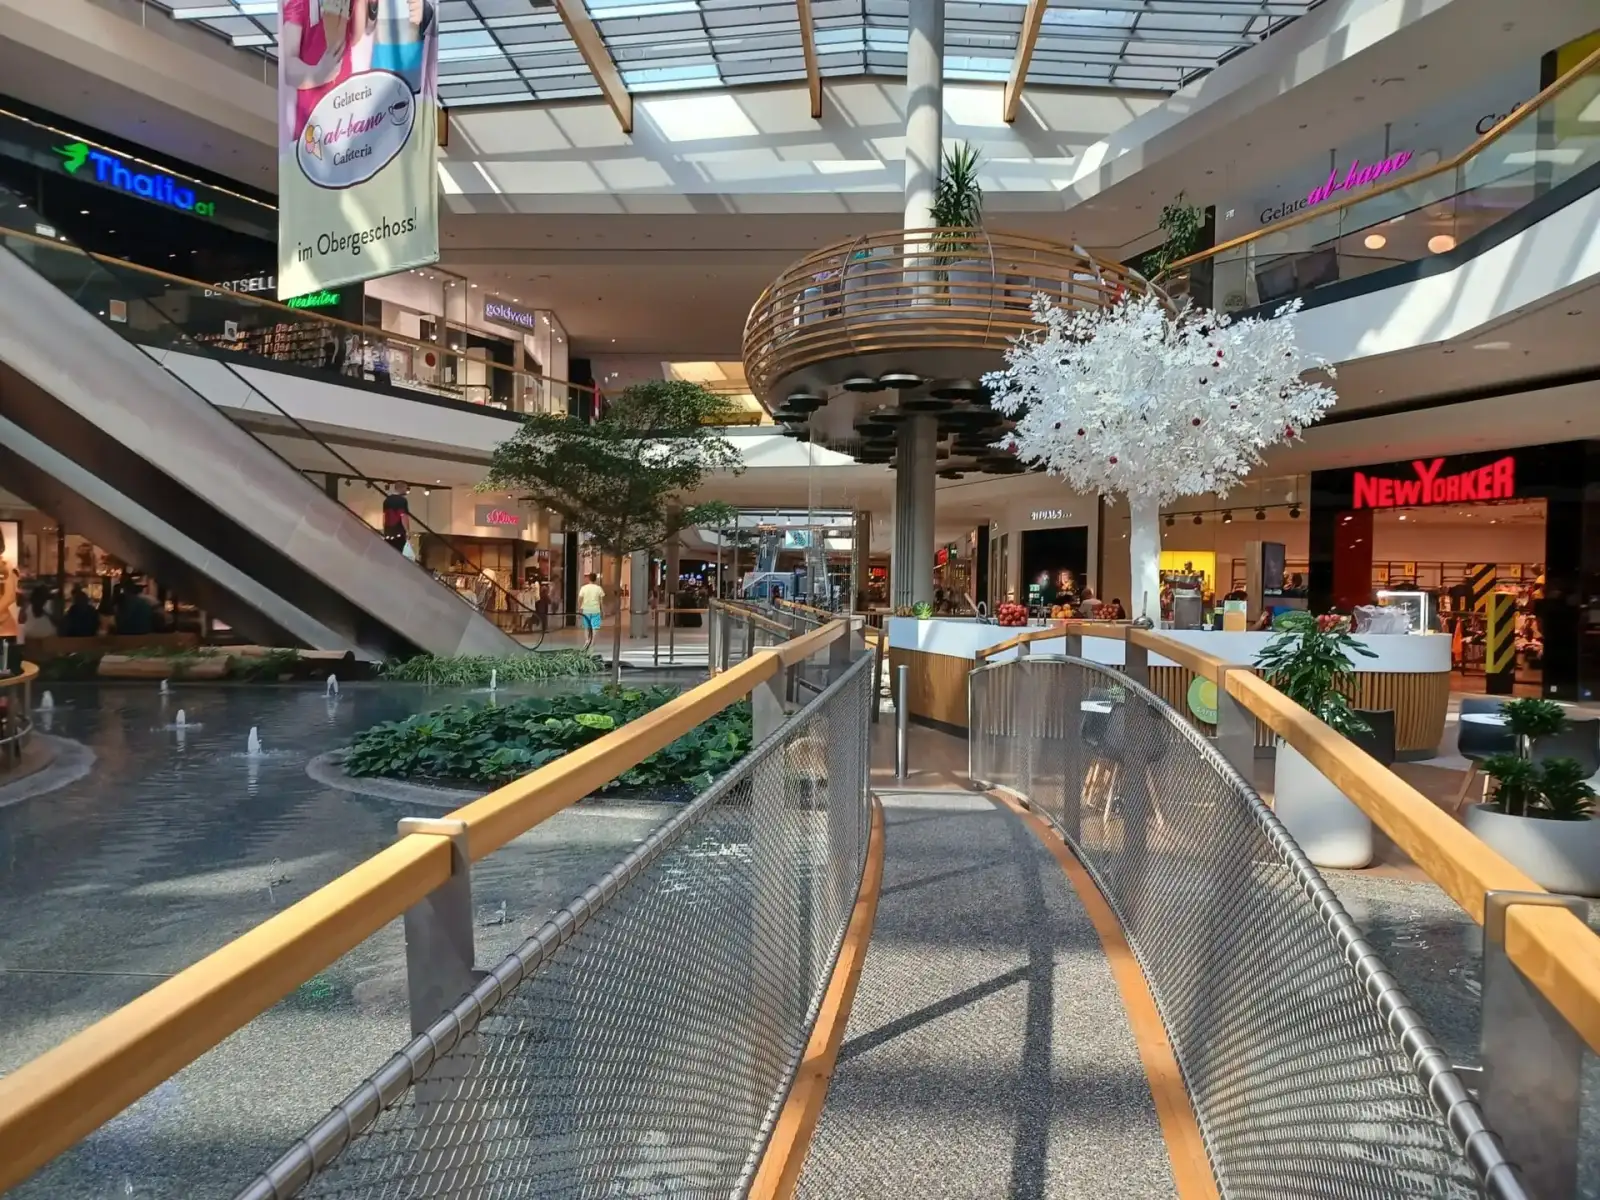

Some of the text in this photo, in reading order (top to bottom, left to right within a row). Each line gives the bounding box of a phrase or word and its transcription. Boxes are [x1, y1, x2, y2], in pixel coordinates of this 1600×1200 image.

[323, 112, 387, 146] al-bano
[1306, 149, 1415, 205] al-bano
[297, 206, 417, 262] im Obergeschoss!
